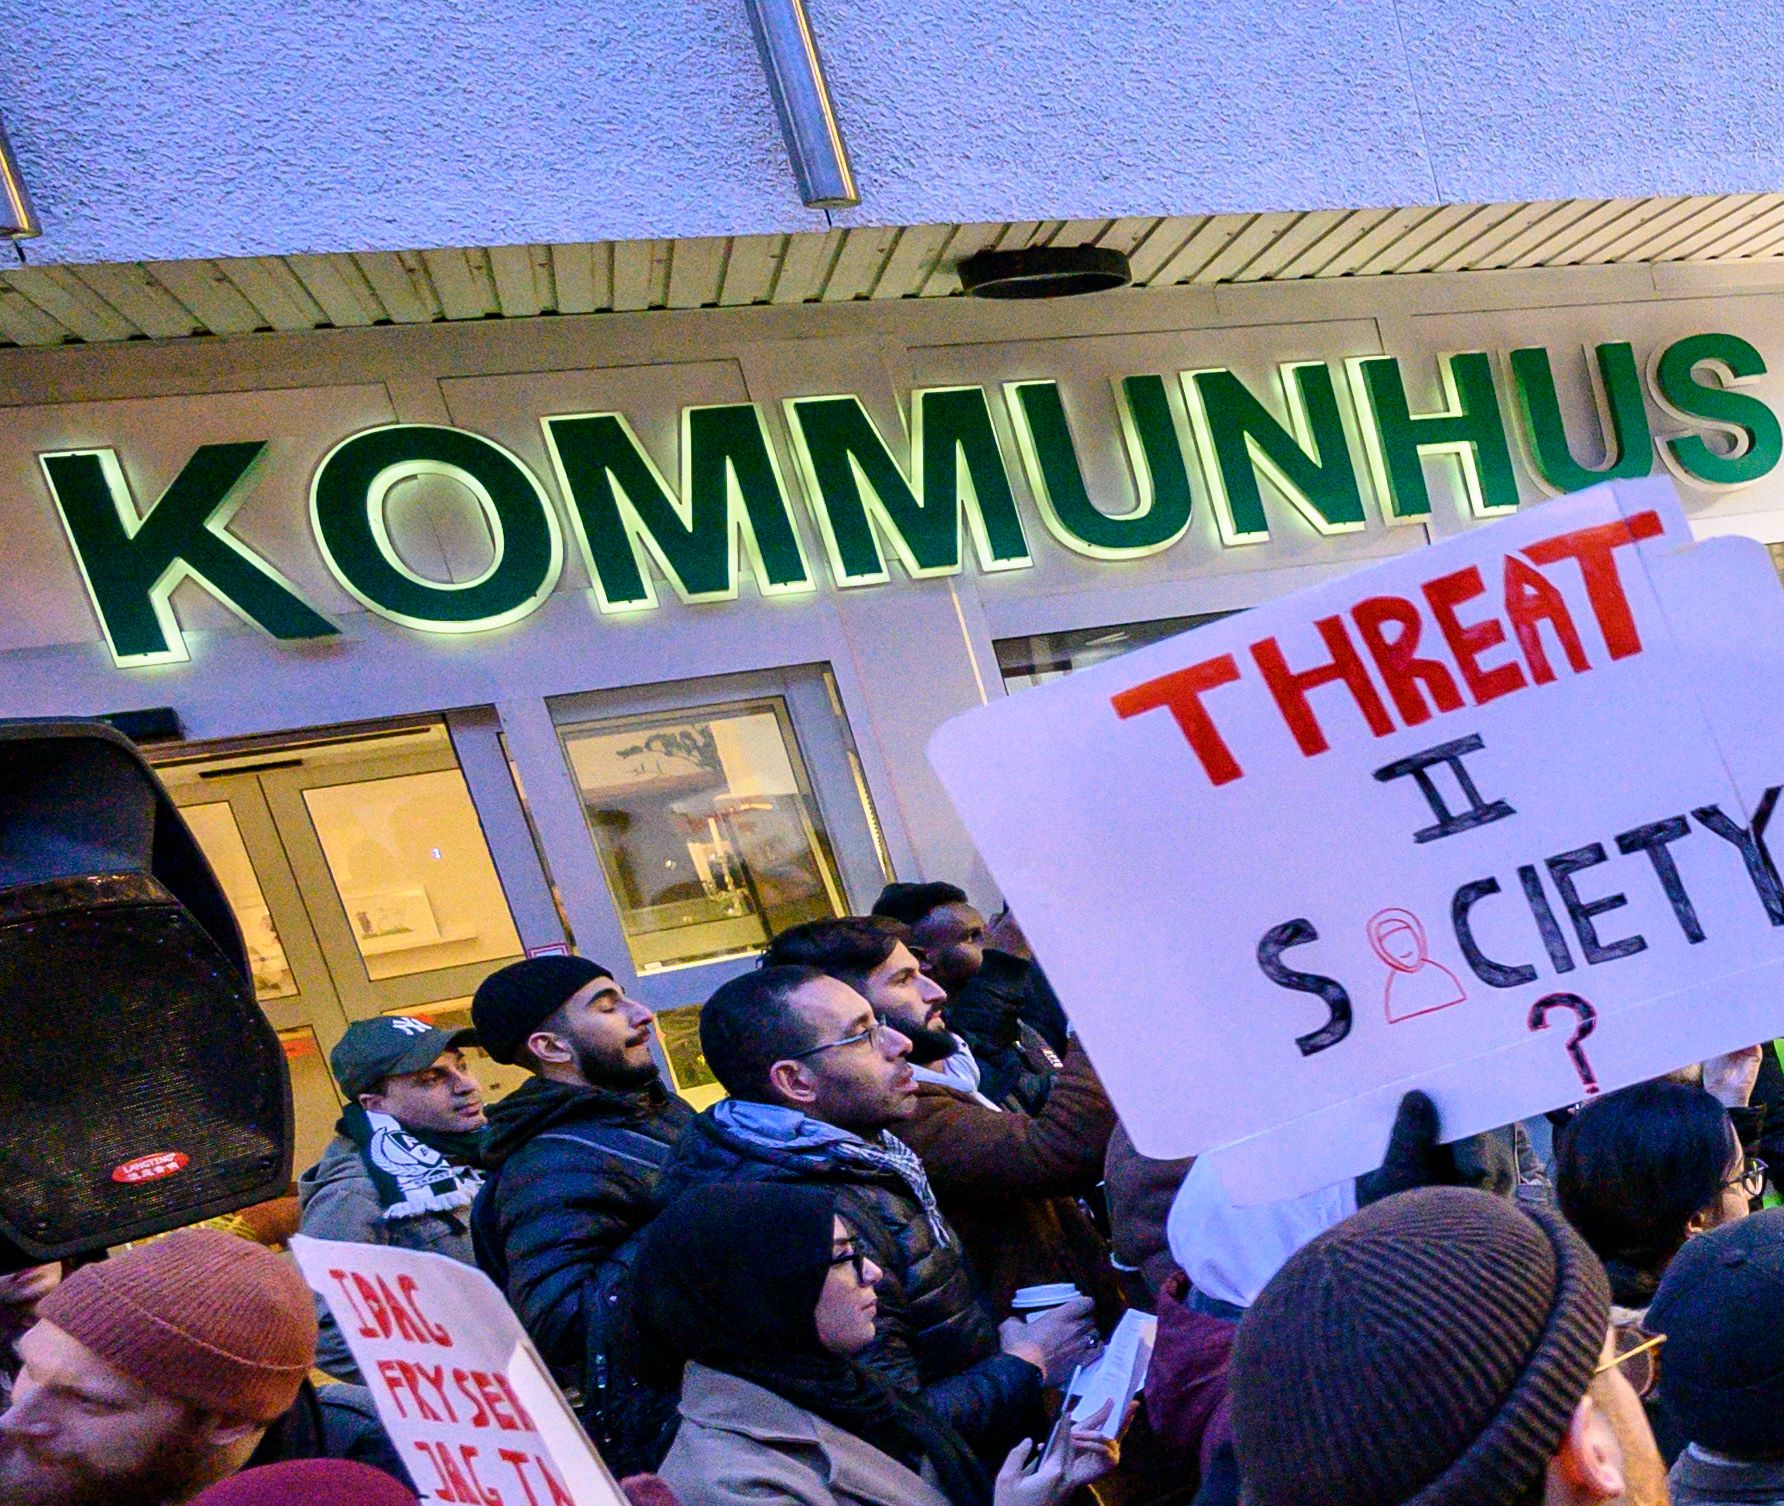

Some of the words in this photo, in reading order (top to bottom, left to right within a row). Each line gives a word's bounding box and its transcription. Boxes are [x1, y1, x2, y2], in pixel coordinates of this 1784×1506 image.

[39, 332, 1783, 668] KOMMUNHUS
[1111, 510, 1664, 786] THREAT
[1374, 733, 1518, 844] II
[1527, 992, 1599, 1095] ?
